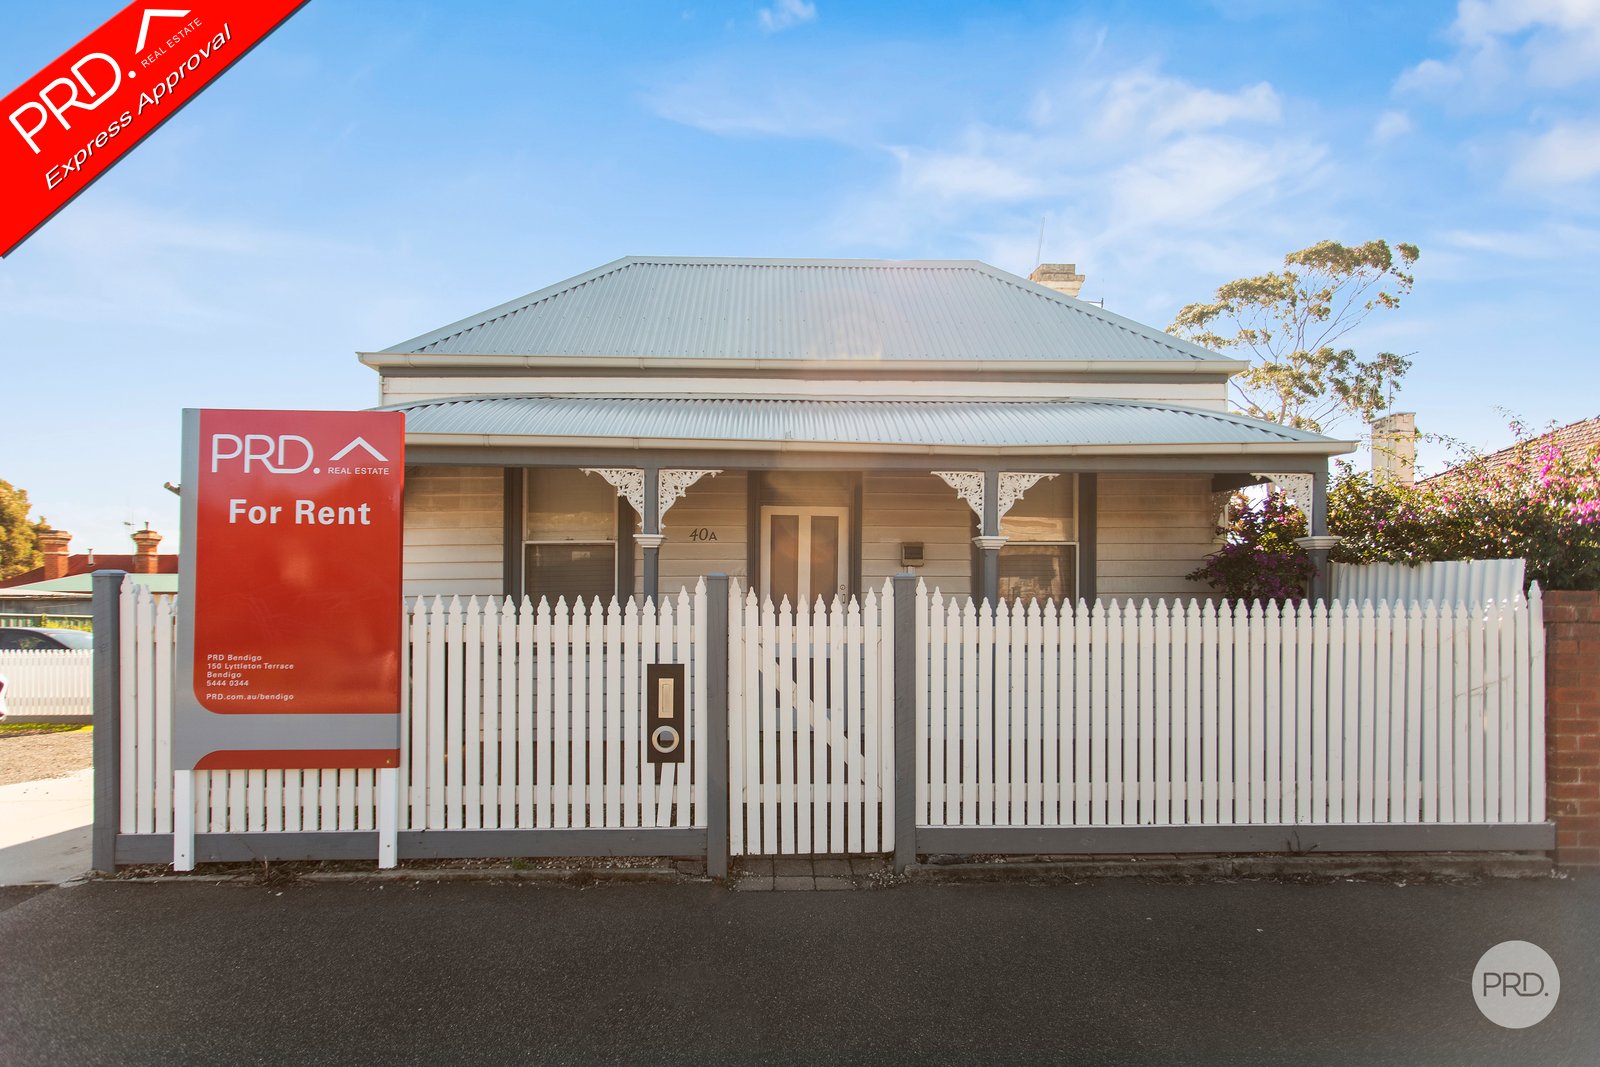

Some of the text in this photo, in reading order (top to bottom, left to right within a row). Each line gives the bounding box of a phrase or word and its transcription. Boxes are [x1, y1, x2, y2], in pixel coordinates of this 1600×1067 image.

[211, 434, 321, 474] PRD.
[328, 467, 390, 475] REAL ESTATE
[228, 498, 371, 525] For Rent
[227, 654, 262, 663] Bendigo
[224, 663, 262, 671] Lyttleton
[263, 662, 294, 670] Terrace
[206, 671, 242, 679] Bendigo
[206, 693, 294, 701] PRD.com.au/bendigo
